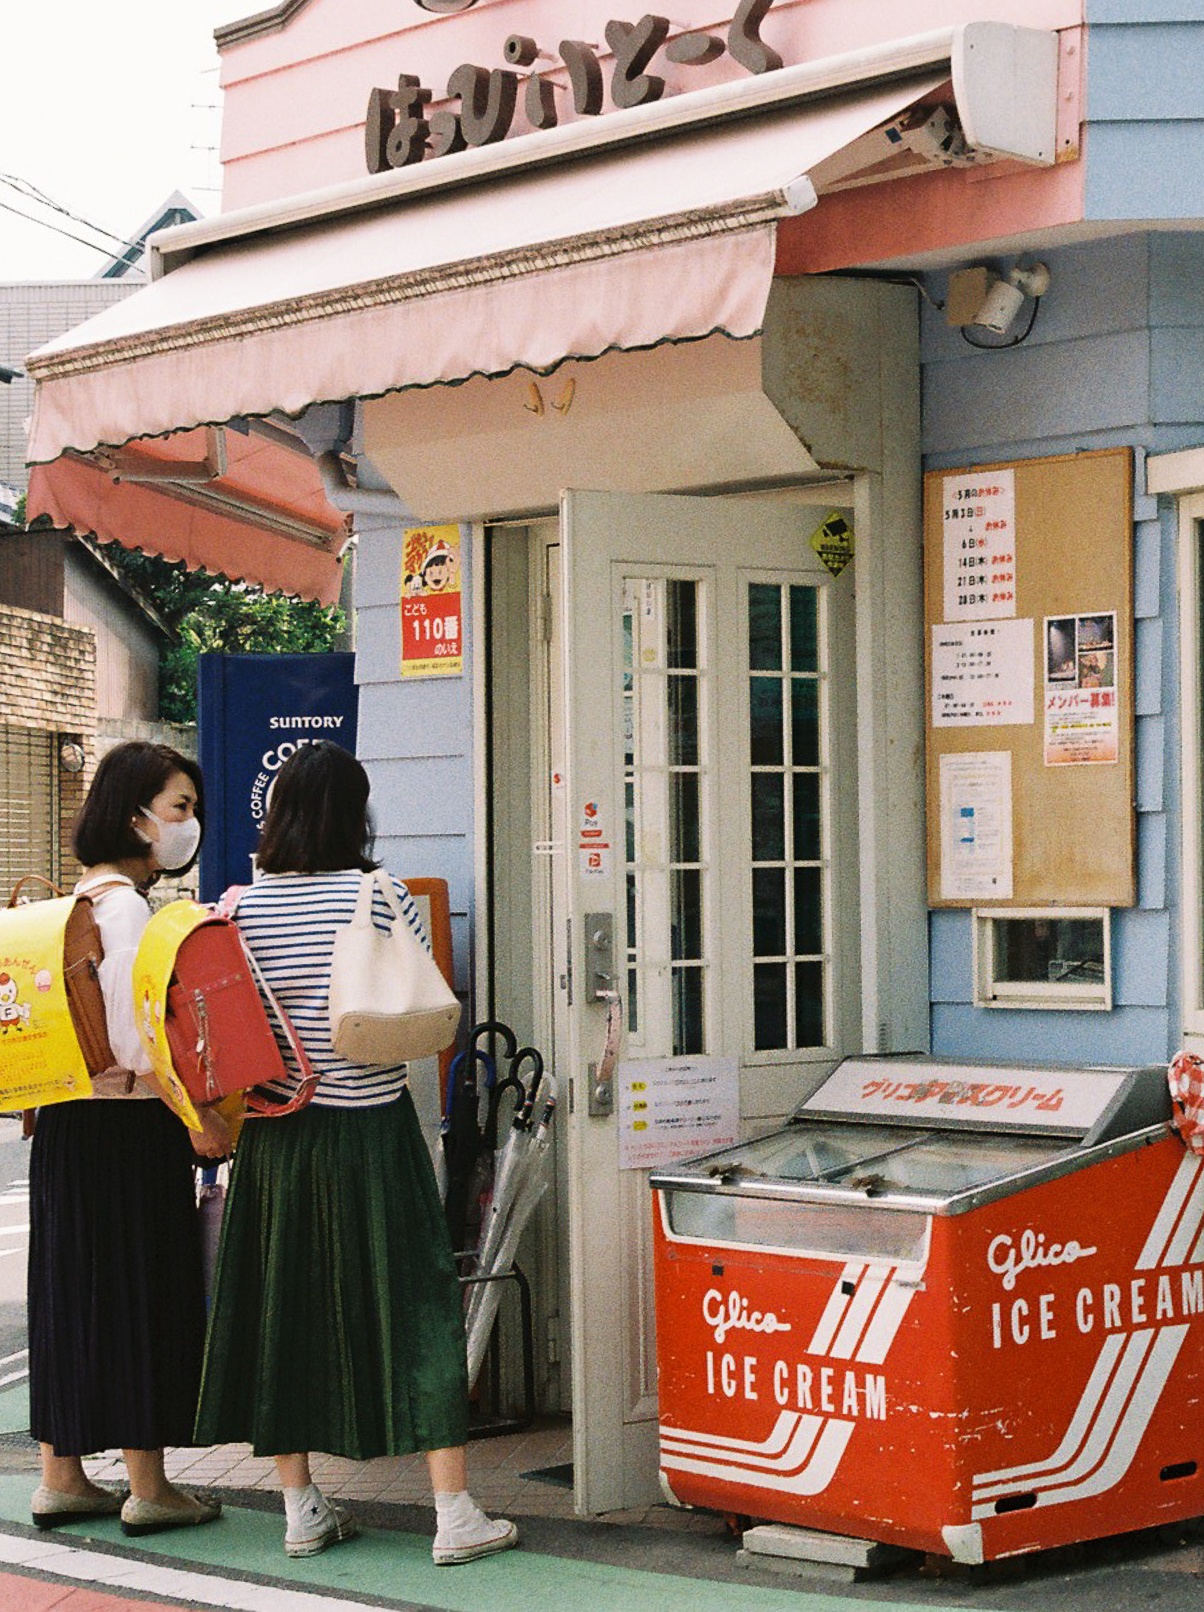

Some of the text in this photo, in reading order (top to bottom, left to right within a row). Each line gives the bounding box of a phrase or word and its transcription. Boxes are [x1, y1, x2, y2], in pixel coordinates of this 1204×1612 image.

[404, 603, 427, 616] こども
[413, 616, 458, 641] 110番
[434, 642, 458, 655] のいえ
[250, 772, 270, 819] COFFEE
[986, 1229, 1098, 1291] Glico
[702, 1290, 791, 1344] Glico
[991, 1294, 1056, 1349] ICE
[706, 1351, 888, 1421] ICE CREAM
